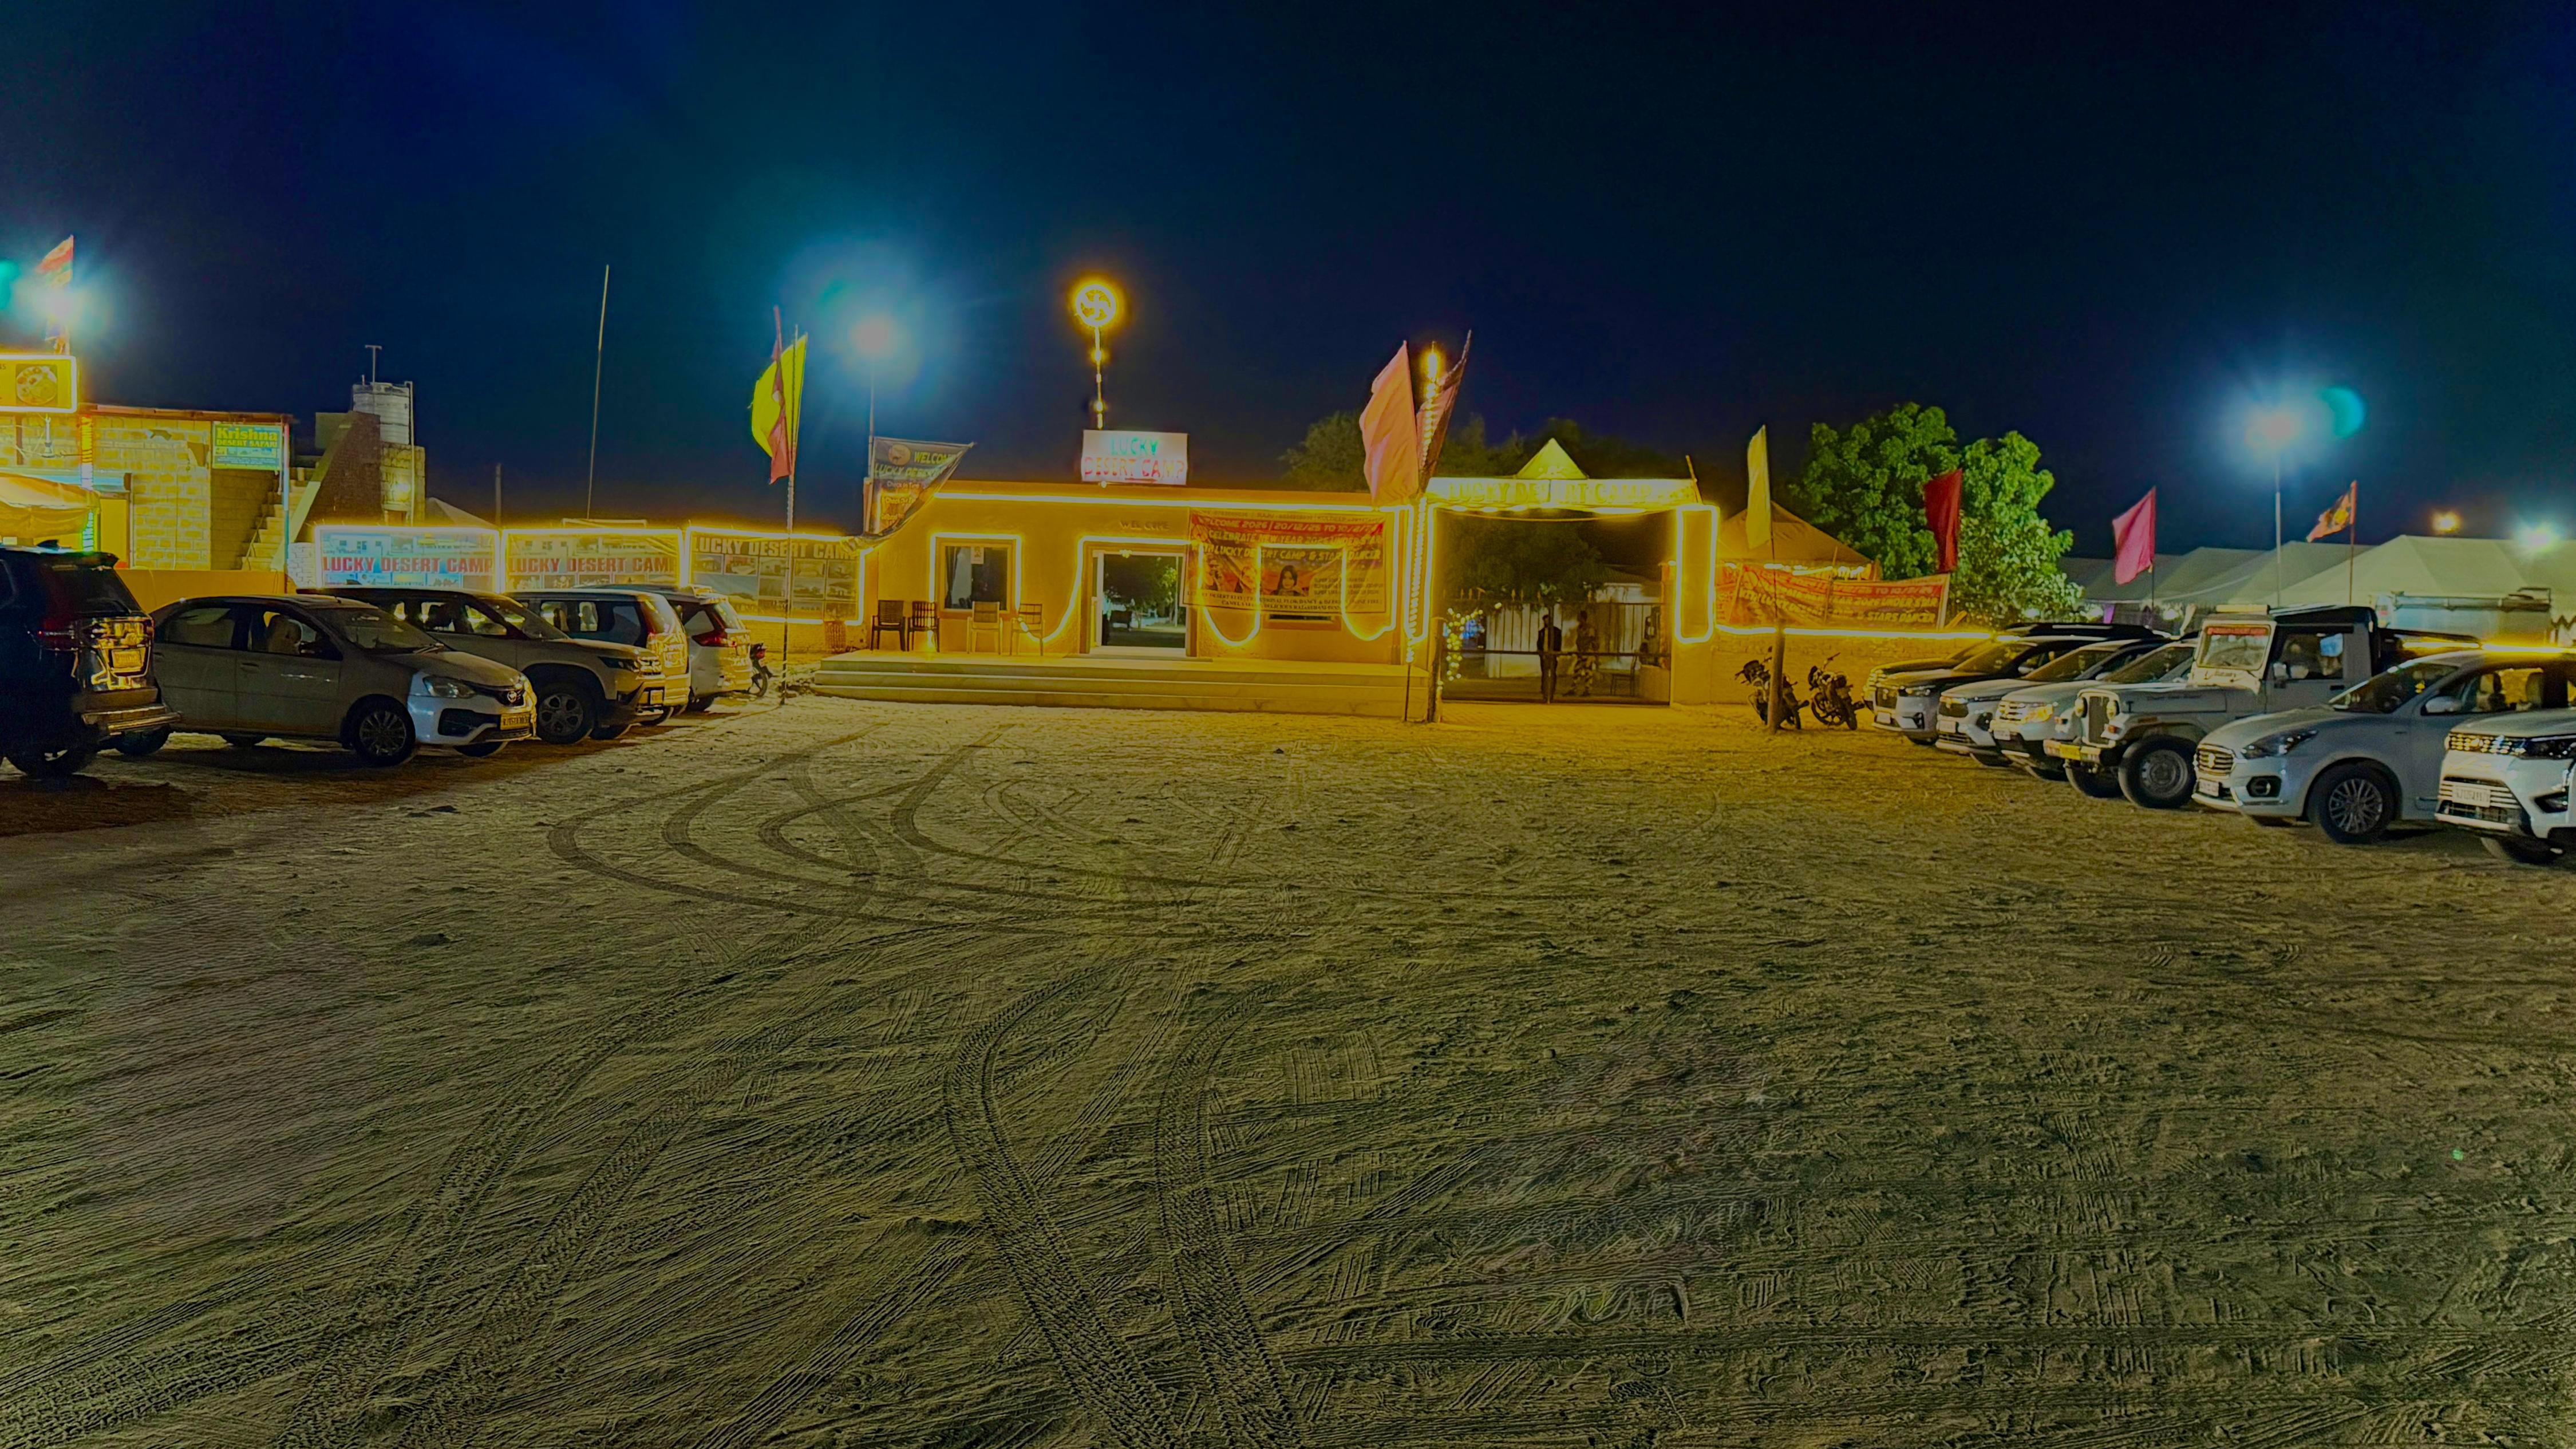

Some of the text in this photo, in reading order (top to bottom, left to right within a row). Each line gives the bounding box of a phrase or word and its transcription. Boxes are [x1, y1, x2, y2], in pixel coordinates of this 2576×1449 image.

[216, 427, 278, 441] Krishna
[1448, 483, 1510, 503] LUCKY
[1594, 483, 1653, 504] CAMP
[1323, 524, 1336, 532] TO
[1277, 534, 1303, 543] YEAR
[694, 536, 744, 555] LUCKY
[748, 540, 807, 558] DESERT
[1279, 548, 1306, 560] CAMP
[322, 556, 375, 572] LUCKY
[381, 557, 441, 573] DESERT
[508, 558, 560, 573] LUCKY
[566, 557, 627, 573] DESERT
